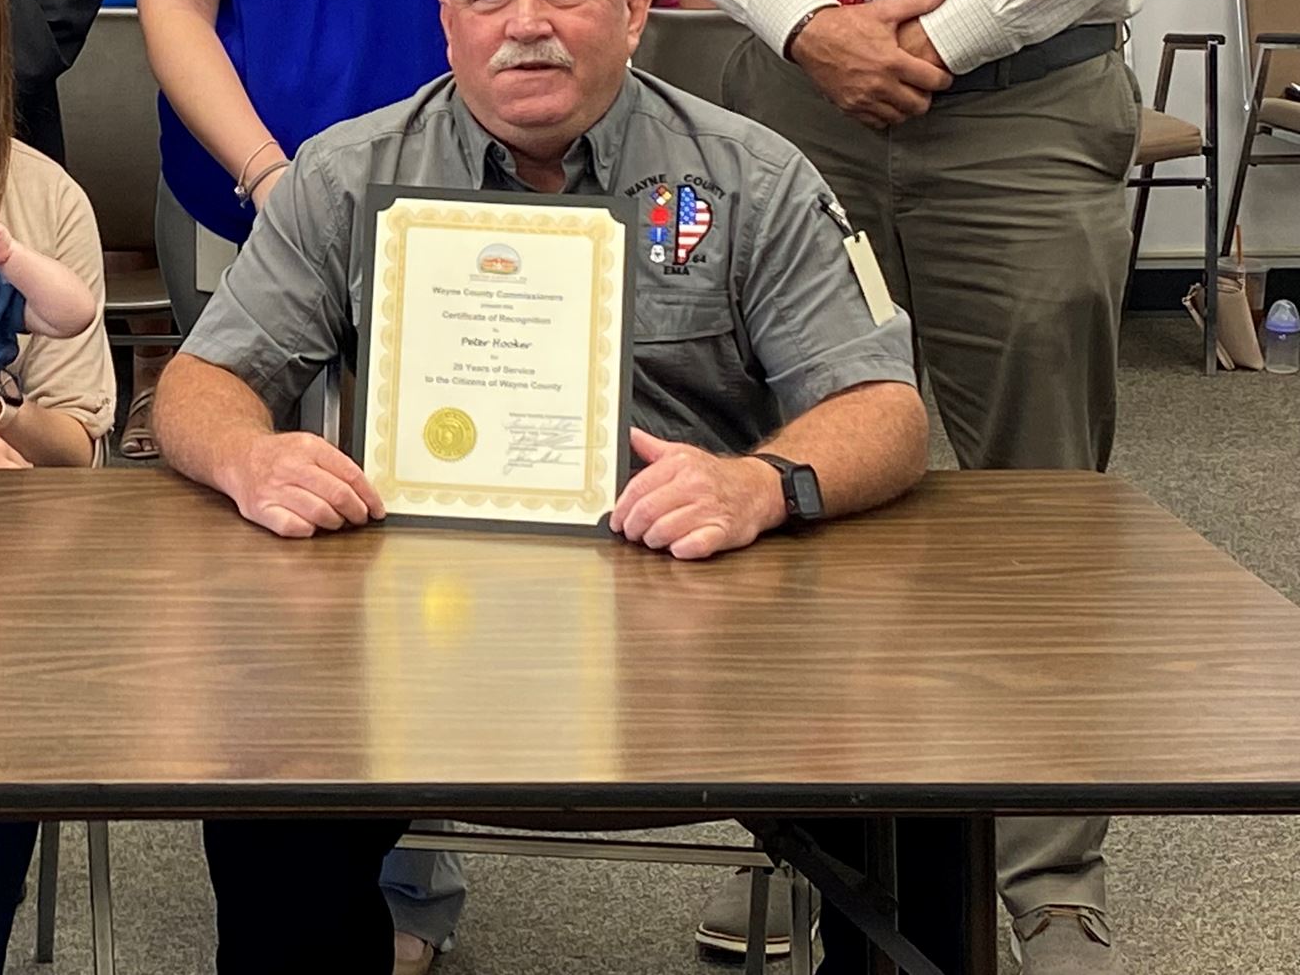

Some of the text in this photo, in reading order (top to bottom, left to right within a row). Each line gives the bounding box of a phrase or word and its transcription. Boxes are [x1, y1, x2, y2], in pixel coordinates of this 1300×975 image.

[625, 174, 726, 199] WAYNE COUNTY
[692, 255, 706, 263] 64
[664, 266, 690, 275] EMA
[432, 287, 563, 301] Wayne County Commissioners
[442, 311, 486, 321] Certificate
[499, 314, 551, 325] Recognition
[461, 337, 532, 349] Peter Hooker
[466, 364, 490, 373] Years
[503, 366, 535, 375] Service
[452, 377, 486, 386] Citizens
[488, 379, 498, 387] of
[500, 380, 528, 389] Wayne
[531, 382, 562, 392] County
